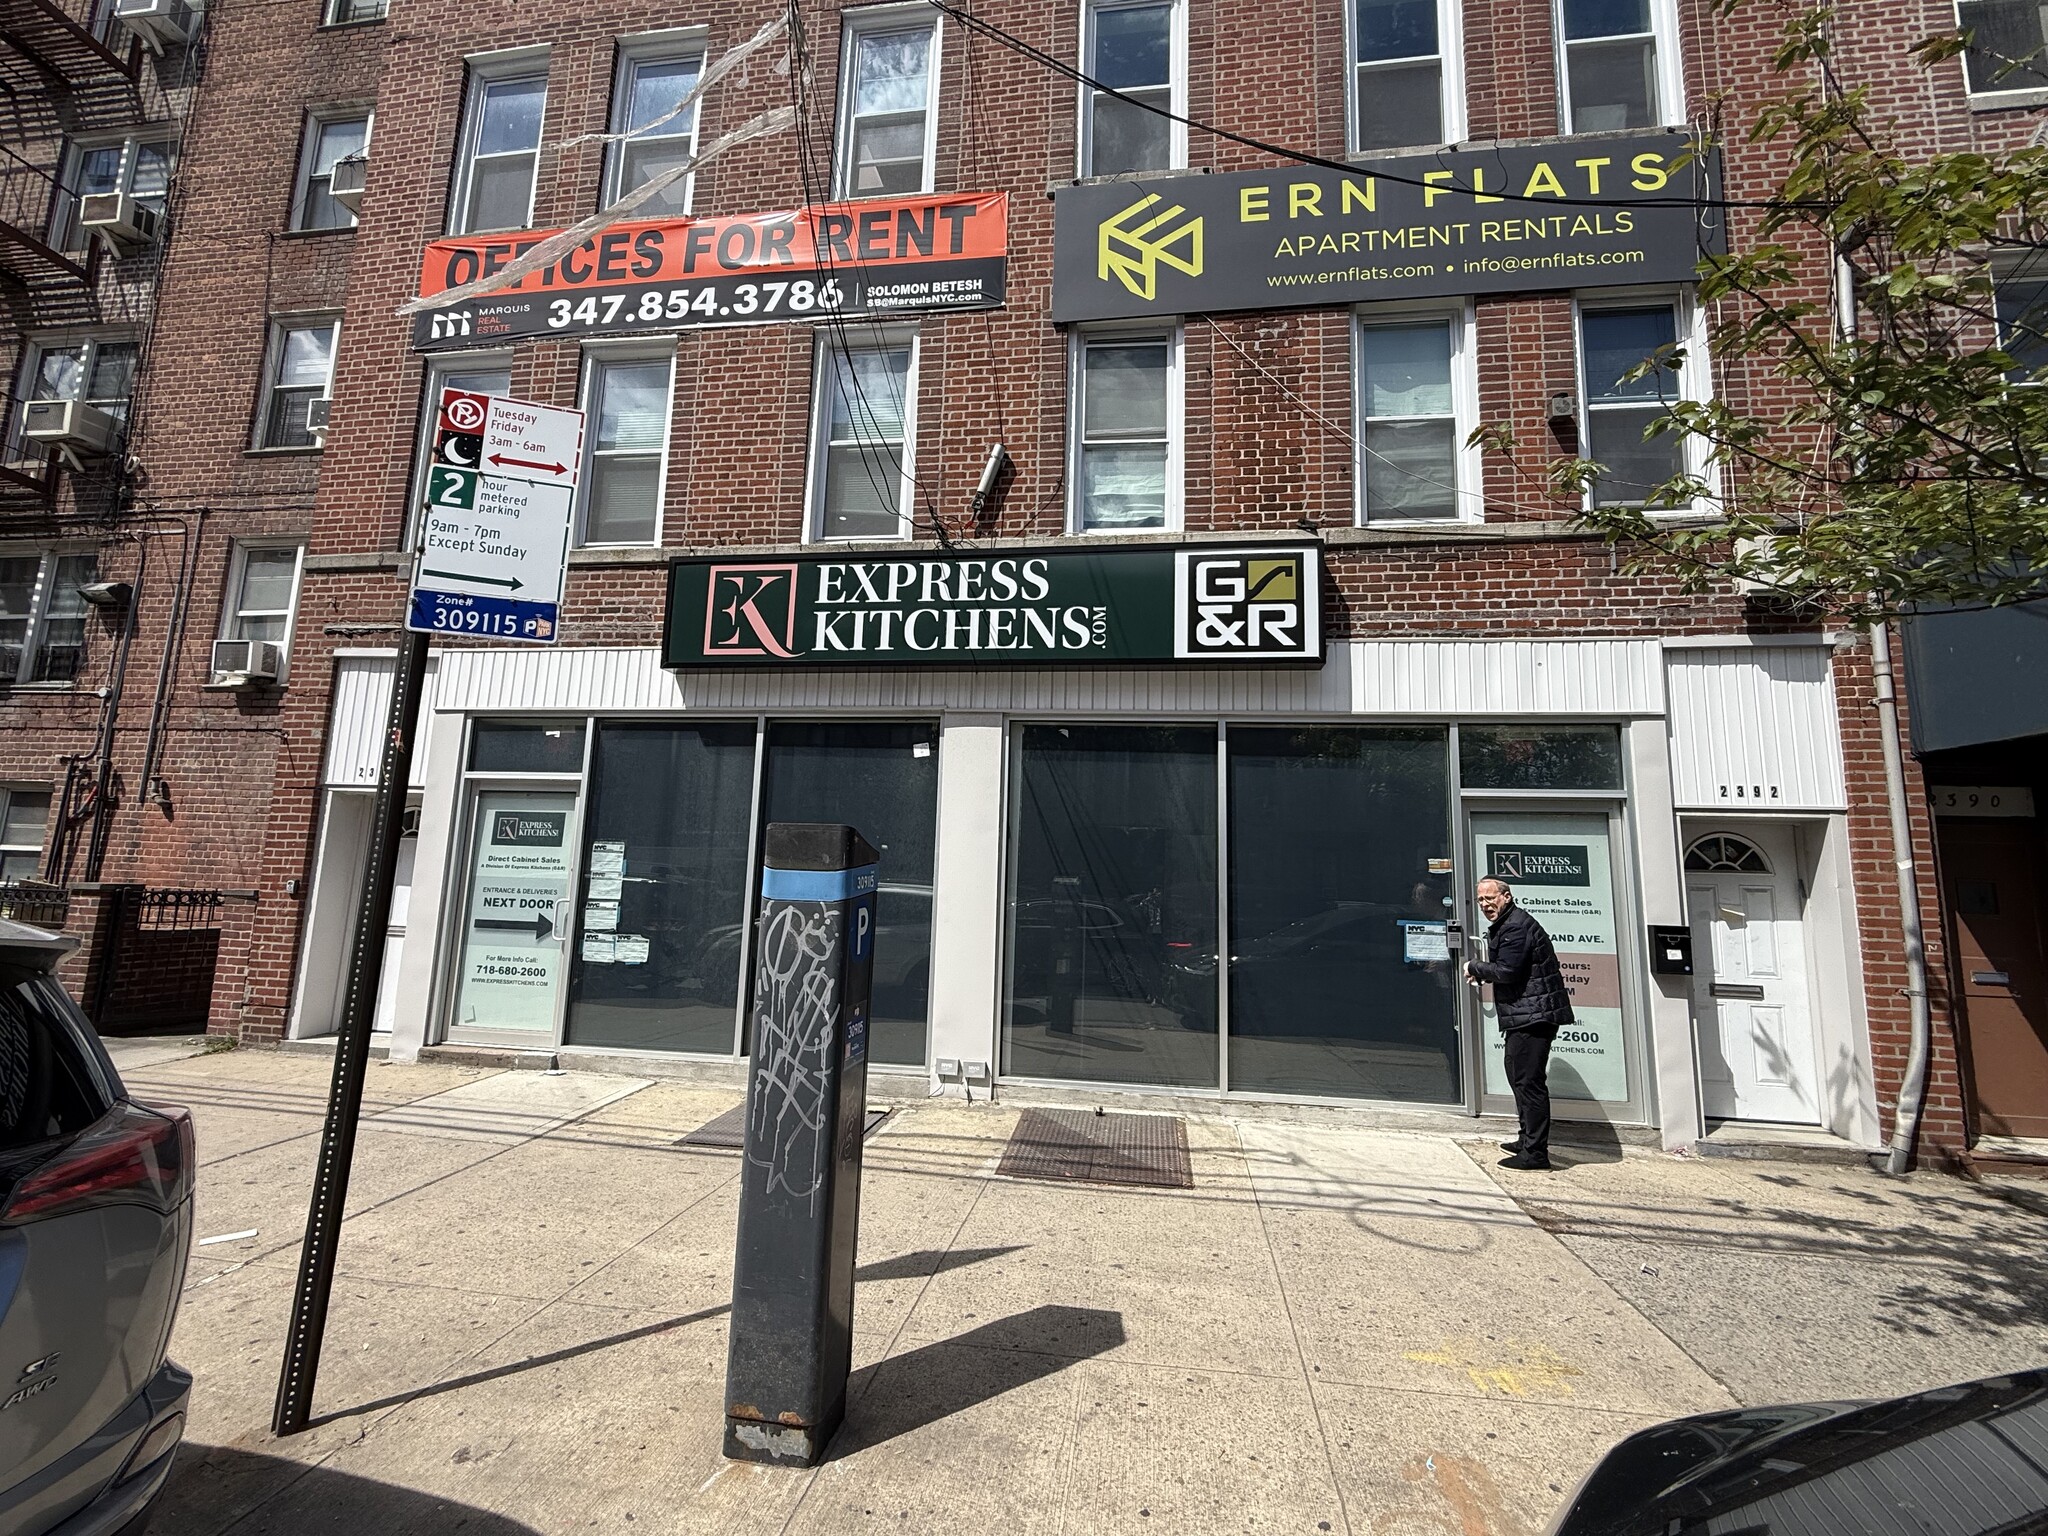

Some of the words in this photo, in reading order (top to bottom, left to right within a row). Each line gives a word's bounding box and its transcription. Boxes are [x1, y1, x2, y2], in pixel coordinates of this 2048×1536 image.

[1239, 176, 1376, 223] ERN
[1423, 152, 1668, 208] FLATS
[683, 220, 796, 273] FOR
[820, 204, 977, 263] RENT
[1274, 222, 1468, 258] APARTMENT
[1480, 210, 1634, 242] RENTALS
[1266, 262, 1434, 287] www.ernflats.com
[1463, 248, 1644, 275] info@ernflats.com
[867, 283, 929, 297] SOLOMON
[932, 279, 983, 292] BETESH
[479, 304, 531, 316] MARQUIS
[547, 278, 844, 328] 347.854.3786
[477, 316, 501, 325] REAL
[476, 324, 511, 335] ESTATE
[493, 407, 538, 425] Tuesday
[490, 420, 524, 436] Friday
[489, 435, 513, 448] 3am
[523, 440, 546, 453] 6am
[440, 472, 465, 505] 2
[482, 480, 508, 492] hour
[480, 492, 528, 507] metered
[478, 503, 521, 519] parking
[431, 519, 459, 534] 9am
[474, 524, 501, 540] 7pm
[428, 534, 475, 553] Except
[478, 541, 528, 561] Sunday
[814, 558, 1050, 604] EXPRESS
[436, 594, 474, 607] Zone#
[432, 607, 518, 635] 309115
[811, 606, 1091, 651] KITCHENS
[518, 829, 556, 837] KITCHENS
[519, 821, 553, 830] EXPRESS
[488, 855, 510, 863] Direct
[511, 855, 539, 863] Cabinet
[540, 856, 561, 864] Sales
[1524, 856, 1571, 865] EXPRESS
[1525, 865, 1578, 874] KITCHENS
[482, 886, 515, 894] ENTRANCE
[522, 888, 558, 896] DELIVERIES
[483, 897, 516, 908] NEXT
[519, 898, 554, 909] DOOR
[1521, 897, 1561, 906] Cabinet
[1564, 899, 1592, 907] Sales
[856, 907, 869, 956] P
[1578, 935, 1604, 943] AVE.
[476, 965, 547, 977] 718-680-2600
[1561, 962, 1591, 971] ours:
[1561, 974, 1590, 985] riday
